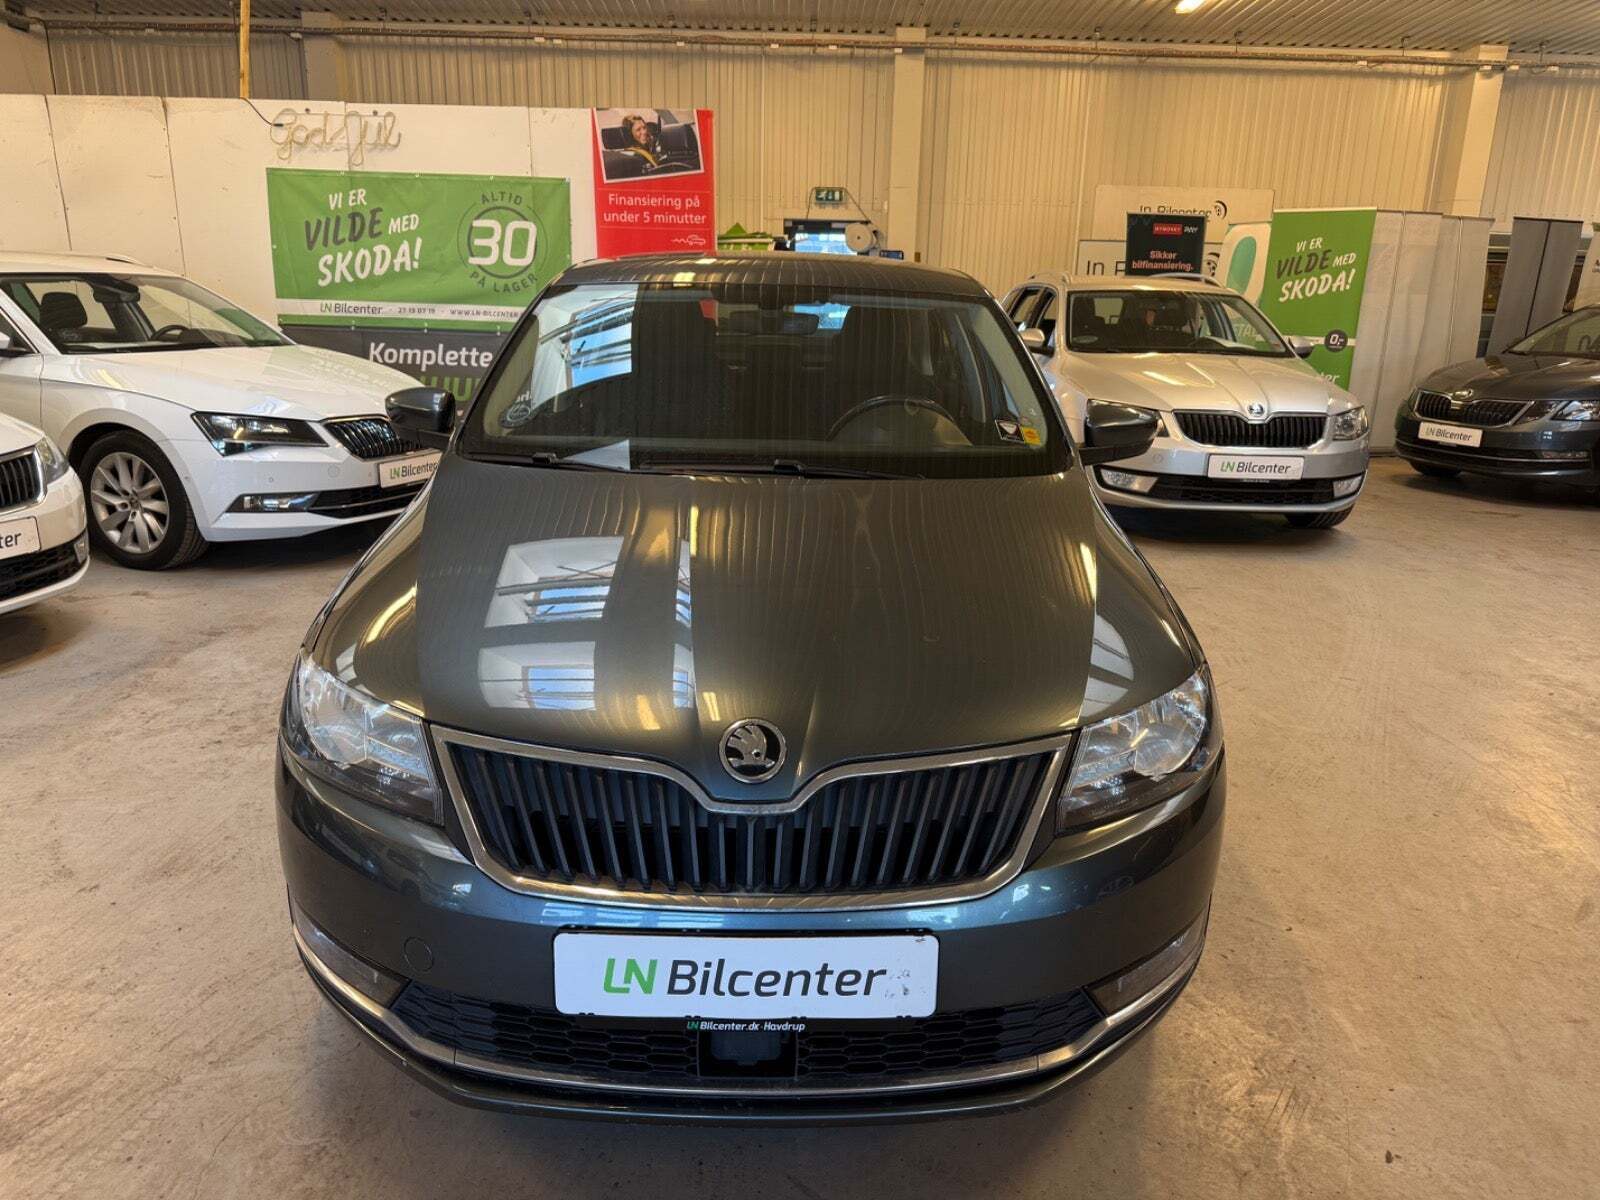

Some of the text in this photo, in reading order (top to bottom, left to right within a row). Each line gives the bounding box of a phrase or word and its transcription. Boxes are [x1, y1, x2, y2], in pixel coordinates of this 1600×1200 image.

[329, 188, 367, 210] VI ER
[481, 192, 522, 205] ALTID
[608, 193, 700, 210] Finansiering på
[603, 210, 706, 224] under 5 minutter
[304, 207, 419, 251] VILDE MED
[468, 219, 537, 266] 30
[1296, 237, 1323, 252] VI ER
[318, 236, 422, 287] SKODA!
[1150, 250, 1177, 259] Sikker
[1087, 260, 1104, 276] In
[1132, 260, 1194, 271] bilfinansiering.
[1277, 250, 1357, 279] VILDE MED
[493, 273, 538, 293] LAGER
[1278, 268, 1356, 302] SKODA!
[334, 303, 383, 314] Bilcenter
[369, 342, 493, 371] Komplette
[1436, 428, 1472, 440] Bilcenter
[1220, 461, 1292, 474] LN Bilcenter
[603, 958, 887, 997] LN Bilcenter
[687, 1021, 699, 1030] LN
[763, 1021, 806, 1033] Havdrup
